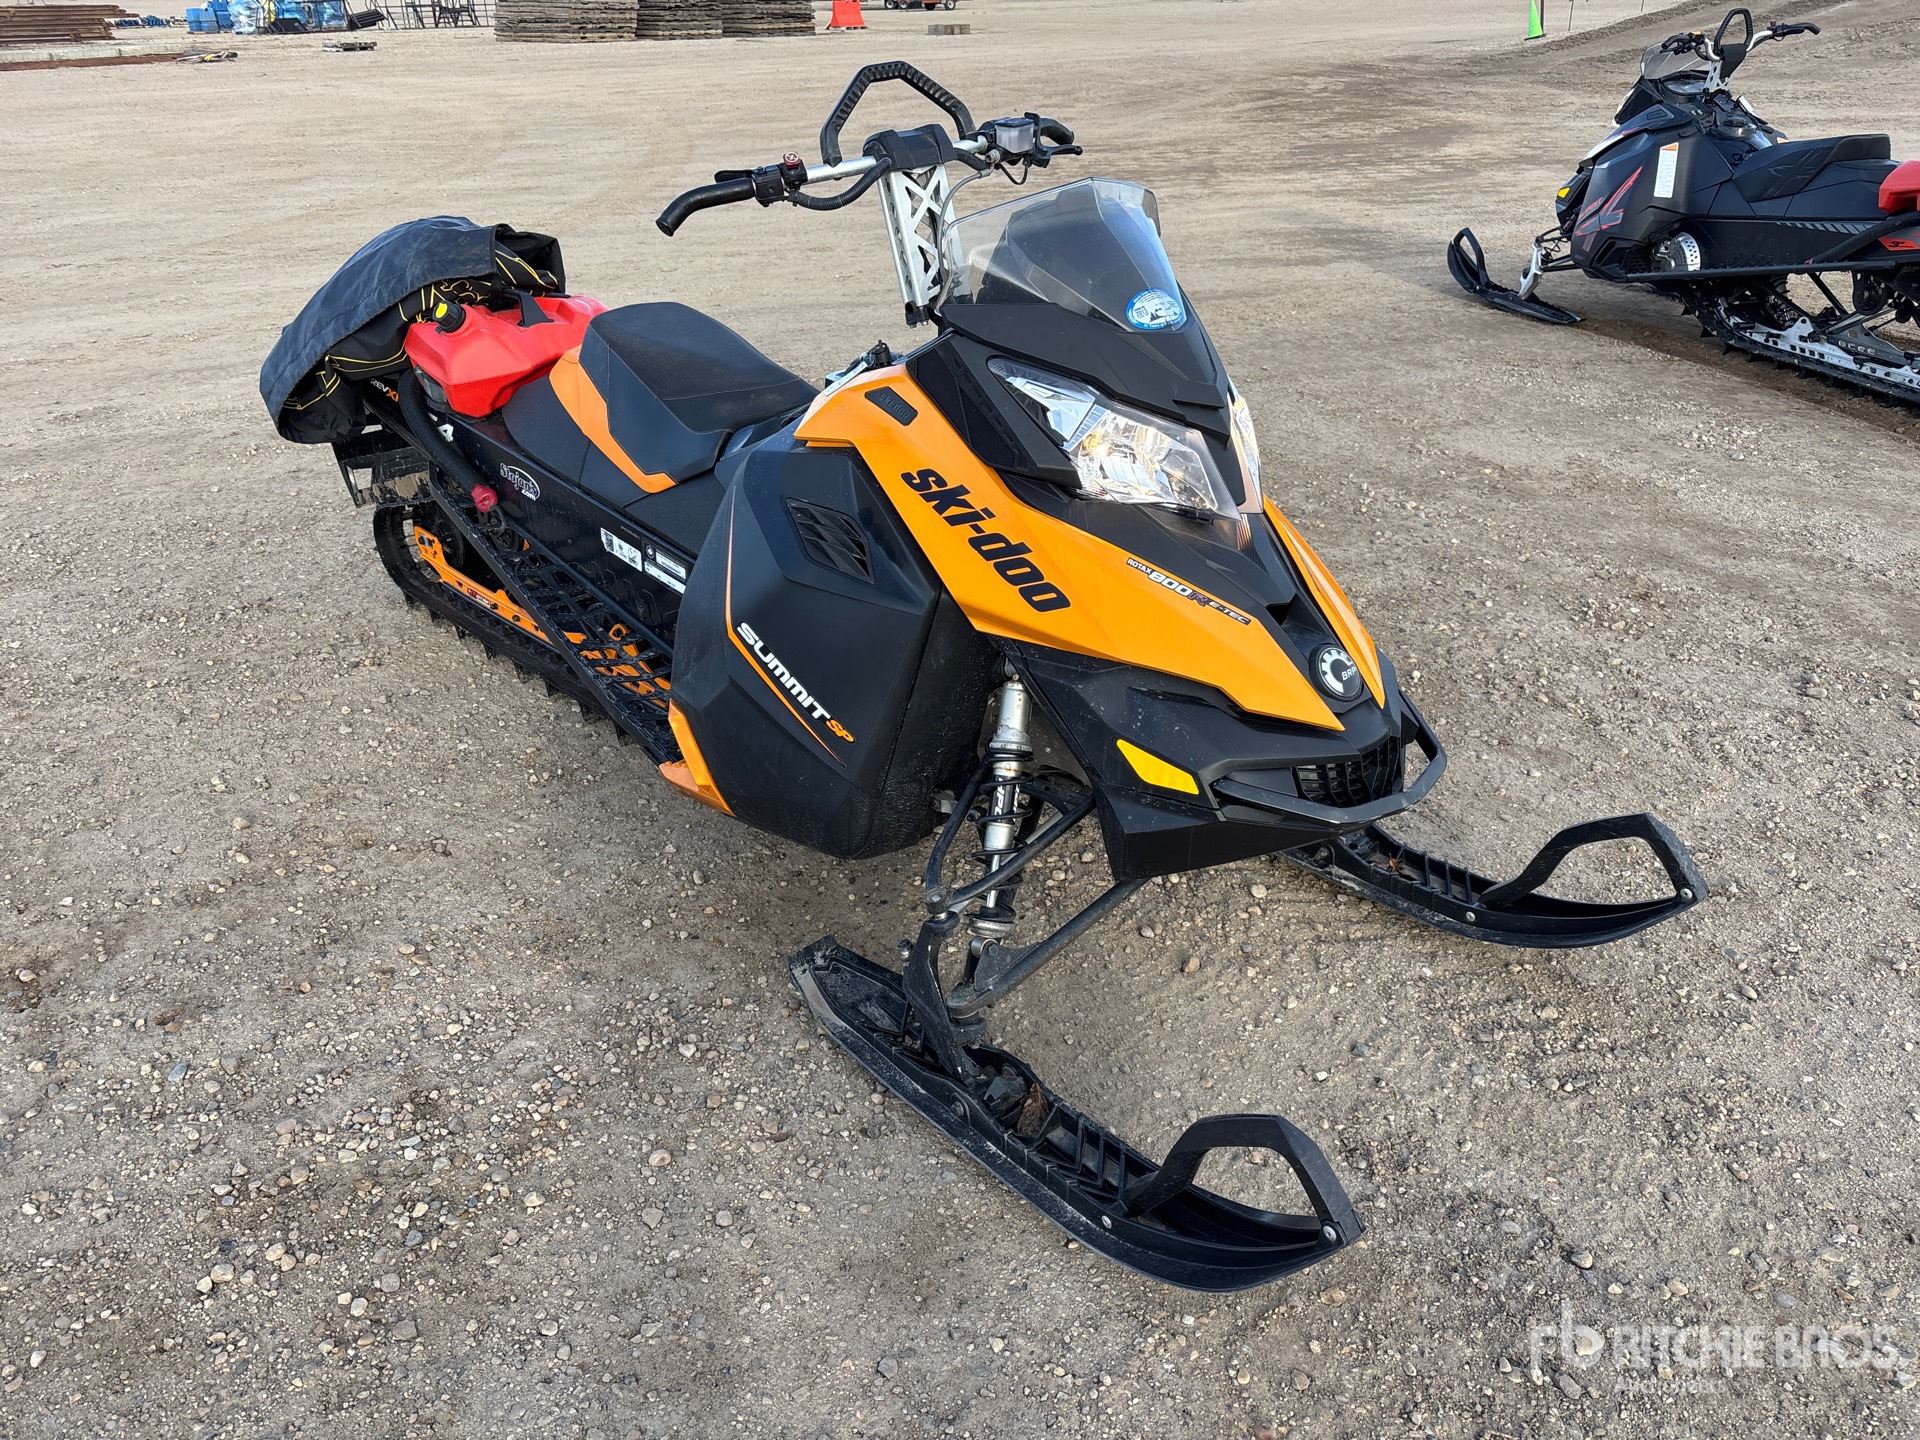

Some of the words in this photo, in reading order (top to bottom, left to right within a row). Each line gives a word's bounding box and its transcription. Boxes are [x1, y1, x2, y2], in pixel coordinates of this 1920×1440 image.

[500, 463, 537, 496] Stojan's
[521, 489, 536, 501] .com
[900, 468, 1070, 612] ski-doo
[1126, 558, 1152, 574] ROTAX
[1148, 570, 1209, 606] 800R
[1208, 601, 1250, 624] E-TEC
[736, 622, 831, 720] SUMMIT
[825, 718, 856, 743] SP
[1341, 666, 1357, 681] BRP
